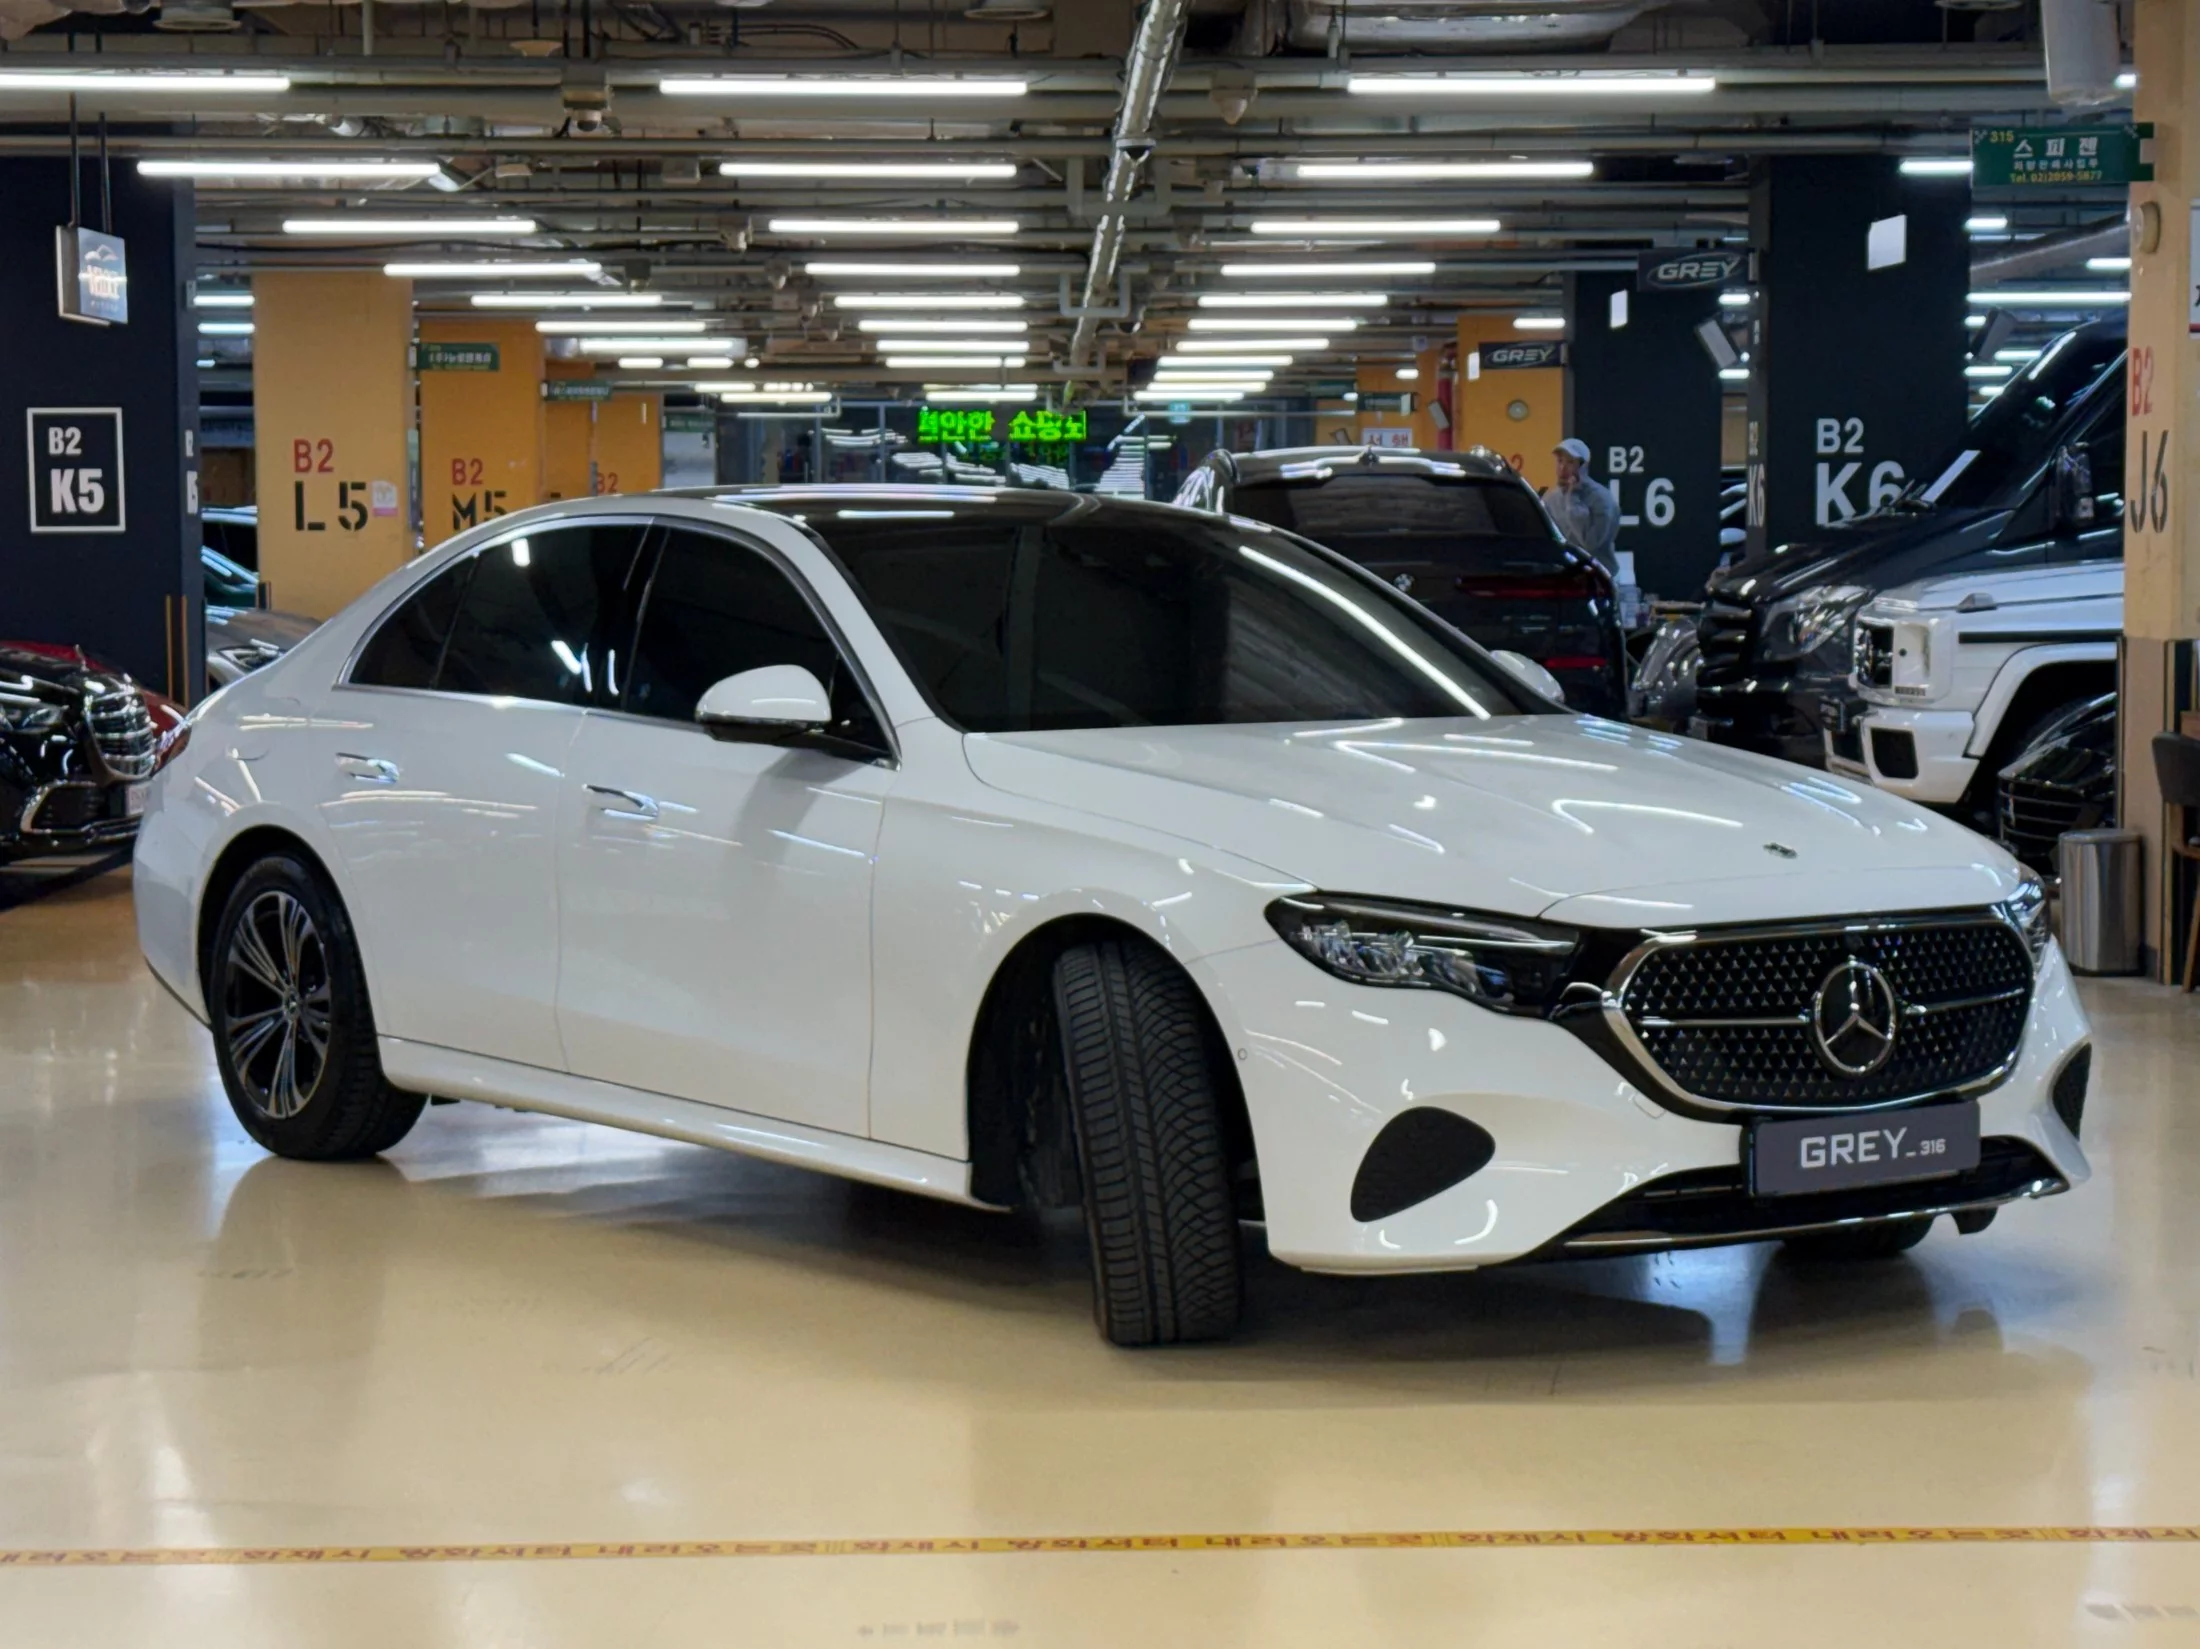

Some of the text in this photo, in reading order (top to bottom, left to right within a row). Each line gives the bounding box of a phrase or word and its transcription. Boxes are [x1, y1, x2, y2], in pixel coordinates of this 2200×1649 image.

[1658, 256, 1741, 279] GREY
[1493, 345, 1556, 362] GREY
[48, 426, 82, 456] B2
[1816, 417, 1865, 453] B2
[294, 438, 334, 473] B2
[452, 458, 484, 486] B2
[1609, 446, 1645, 473] B2
[51, 468, 105, 514] K5
[1816, 460, 1906, 527] K6
[2130, 430, 2169, 533] J6
[295, 480, 368, 531] L5
[1609, 477, 1675, 527] L6
